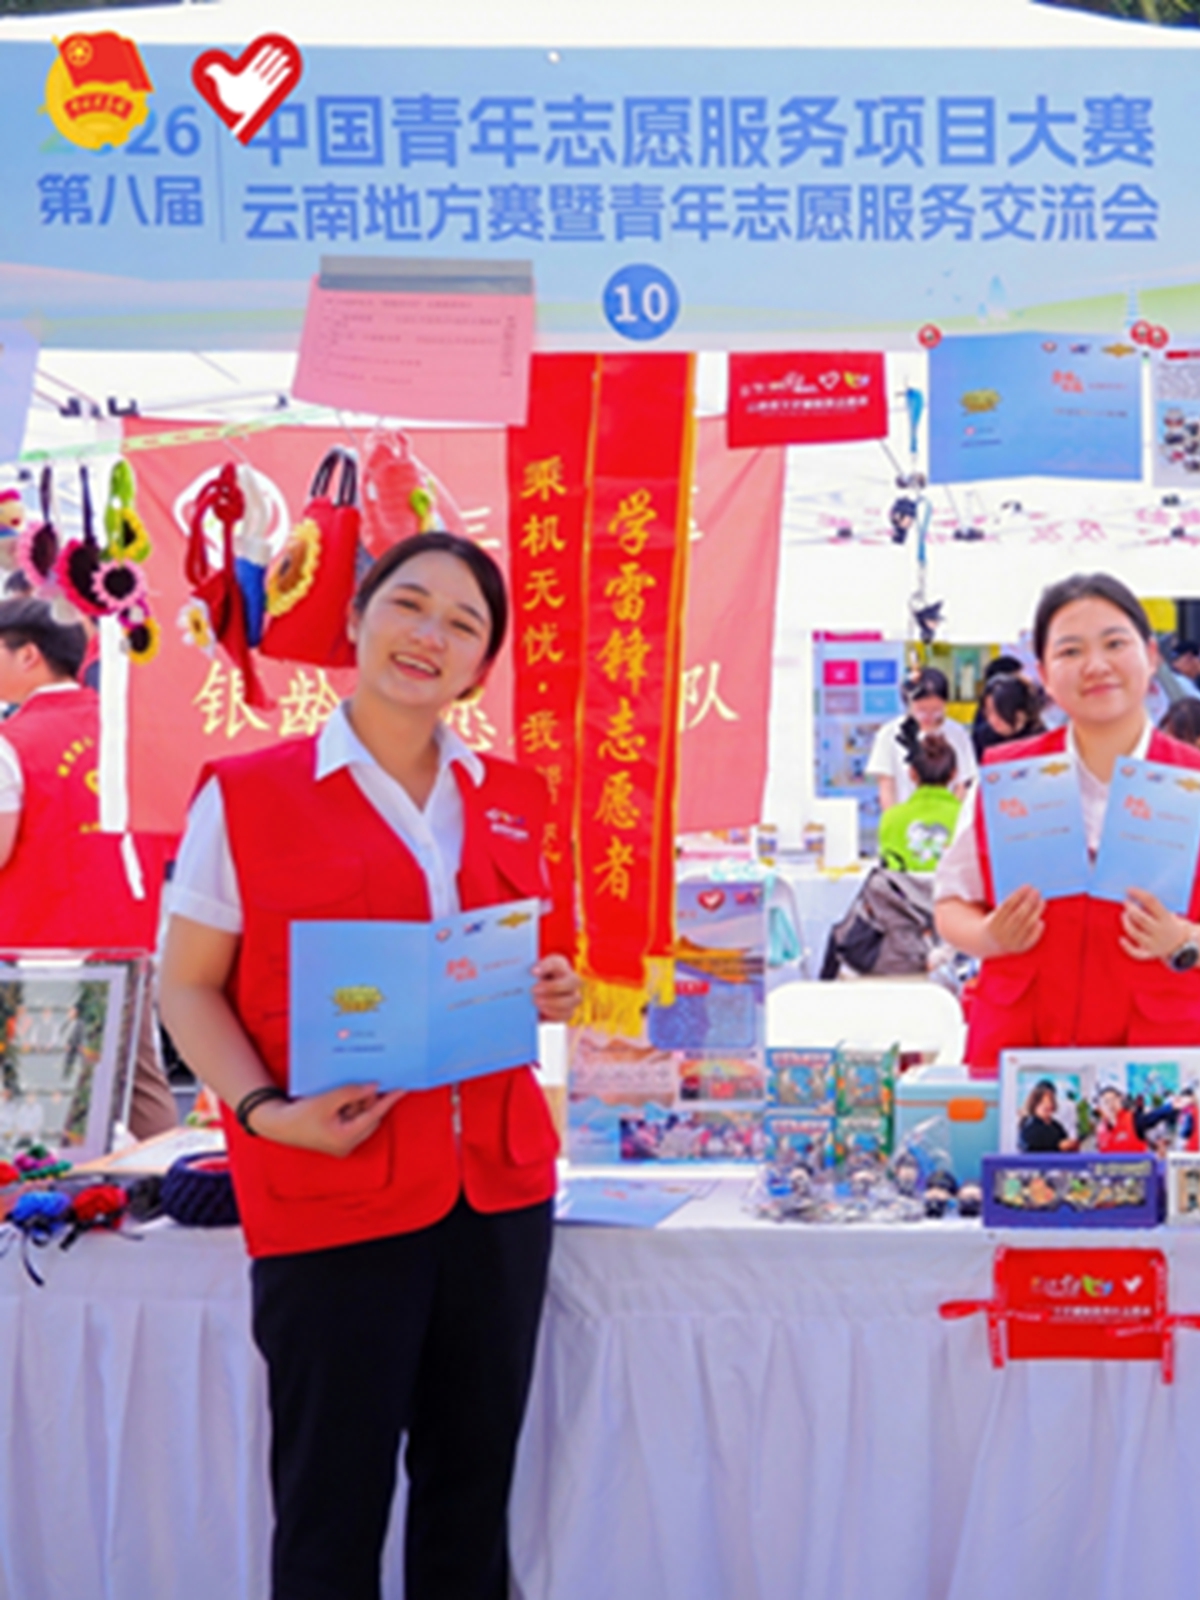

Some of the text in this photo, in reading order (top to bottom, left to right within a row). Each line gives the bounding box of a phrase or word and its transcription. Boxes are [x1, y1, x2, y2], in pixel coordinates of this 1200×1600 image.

[38, 105, 202, 157] 26
[247, 95, 1156, 168] 中国青年志愿服务项目大赛
[37, 173, 205, 227] 第八届
[242, 182, 1160, 243] 云南地方赛暨青年志愿服务交流会
[612, 284, 671, 323] 10
[592, 487, 659, 901] 学雷锋志愿者
